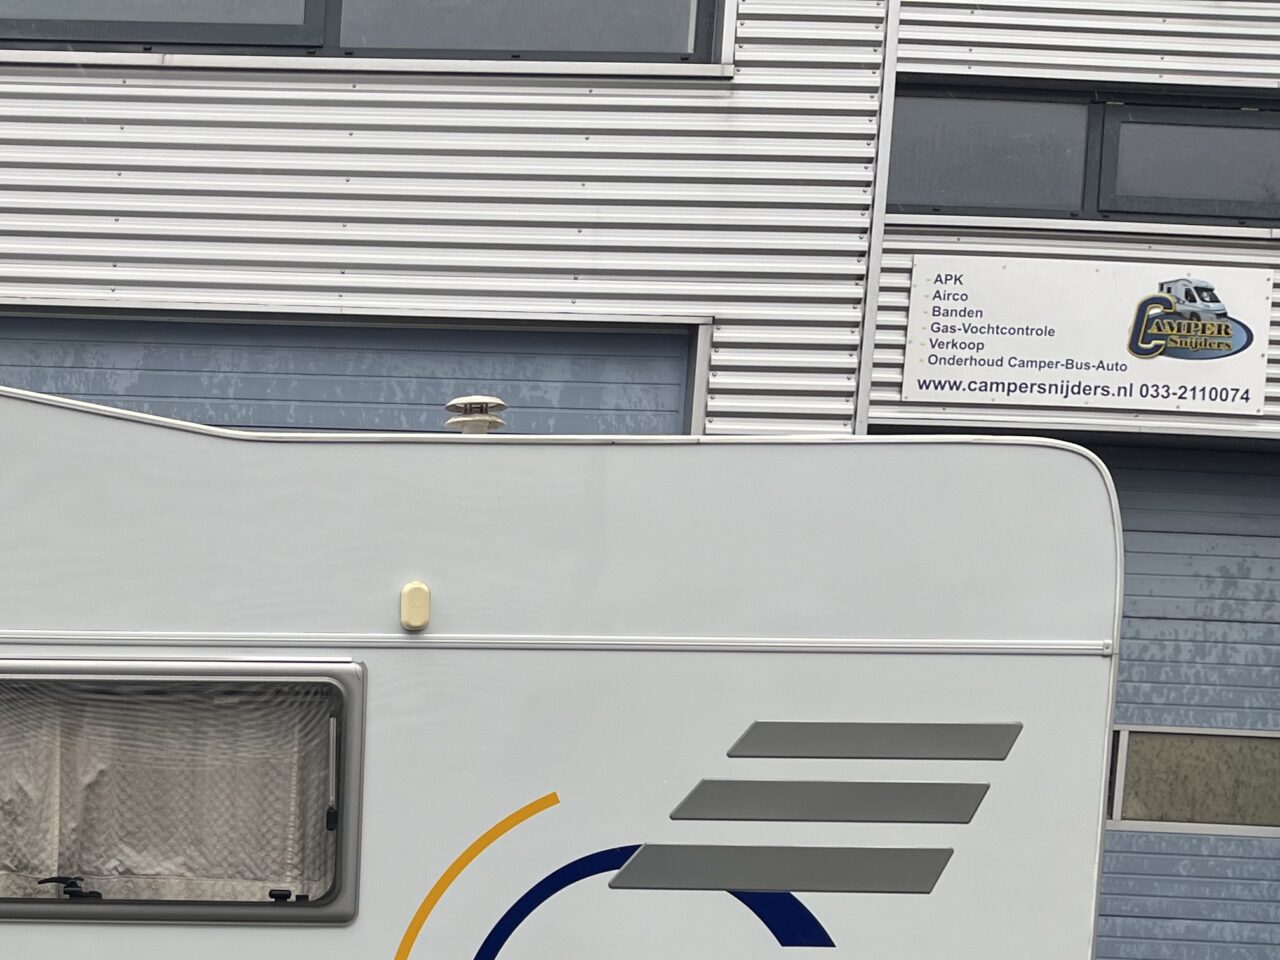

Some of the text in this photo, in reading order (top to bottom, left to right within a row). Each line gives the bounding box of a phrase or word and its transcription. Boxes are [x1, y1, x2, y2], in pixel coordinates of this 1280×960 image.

[933, 273, 964, 286] APK
[932, 289, 969, 302] Airco
[931, 305, 983, 319] Banden
[930, 321, 1056, 337] Gas-Vochtcontrole
[929, 337, 985, 353] Verkoop
[1167, 335, 1232, 352] Snijders
[927, 353, 1128, 372] Onderhoud Camper-Bus-Auto
[917, 379, 1251, 403] www.campersnijders.nl 033-2110074
